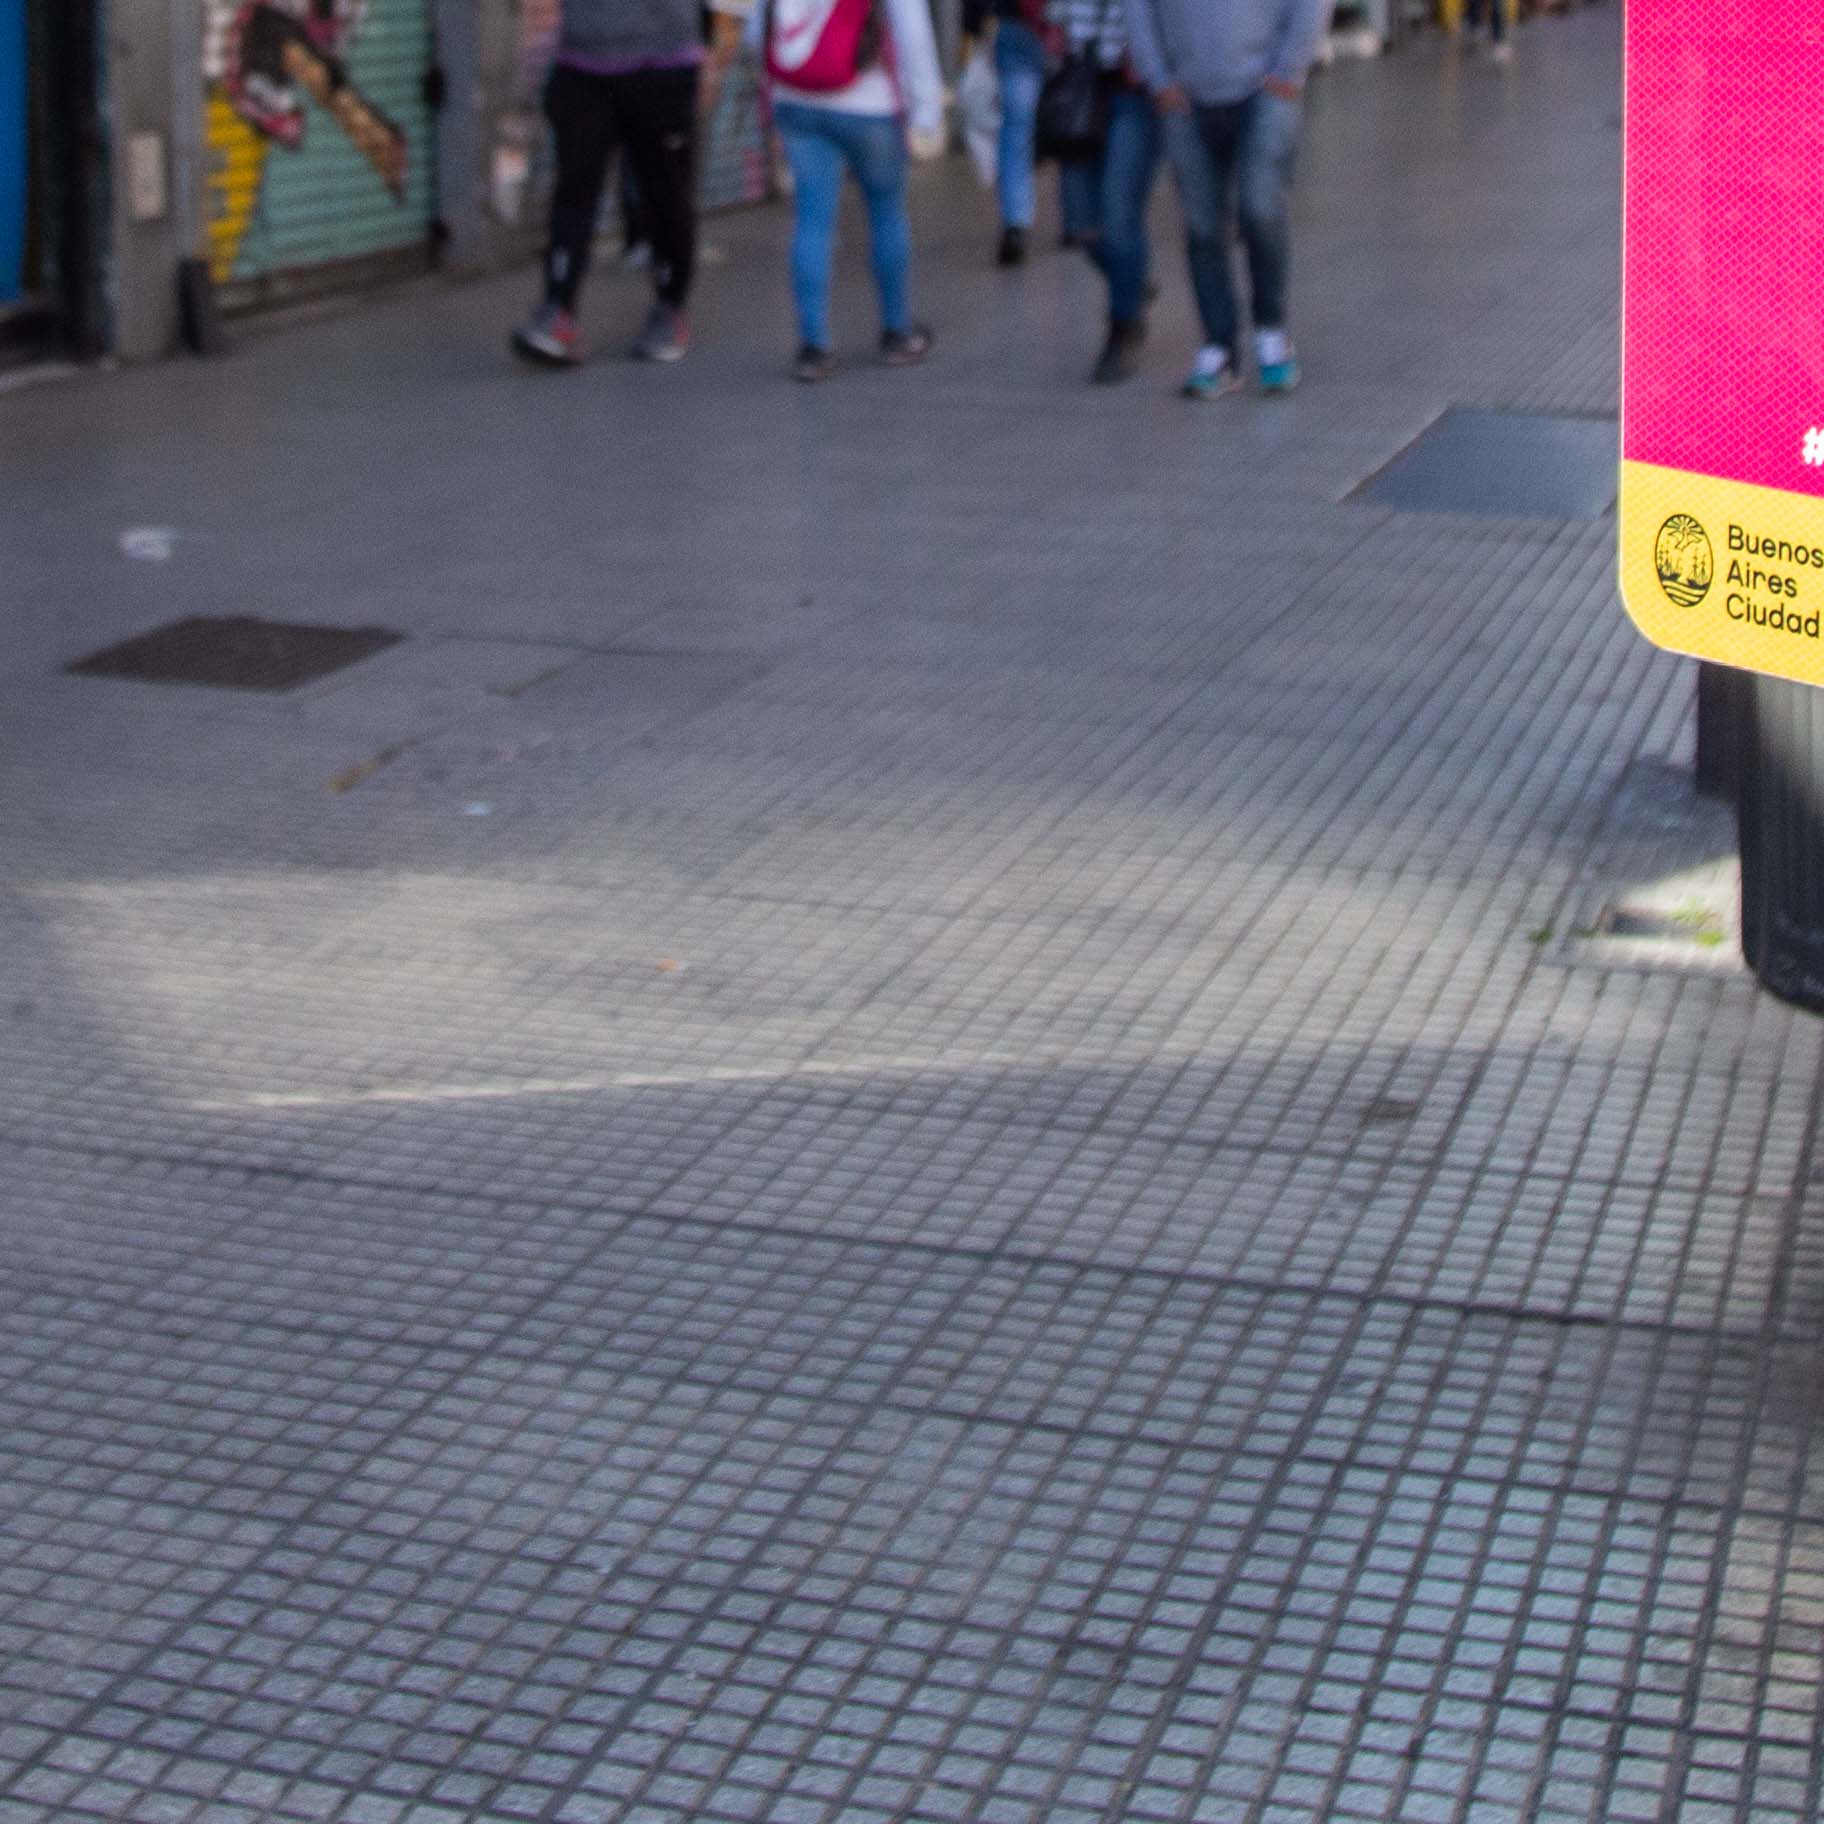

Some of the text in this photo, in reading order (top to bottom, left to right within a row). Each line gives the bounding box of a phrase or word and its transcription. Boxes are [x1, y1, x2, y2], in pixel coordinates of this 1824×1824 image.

[1729, 526, 1823, 568] Buenos
[1727, 561, 1796, 597] Aires
[1727, 594, 1819, 637] Ciudad
